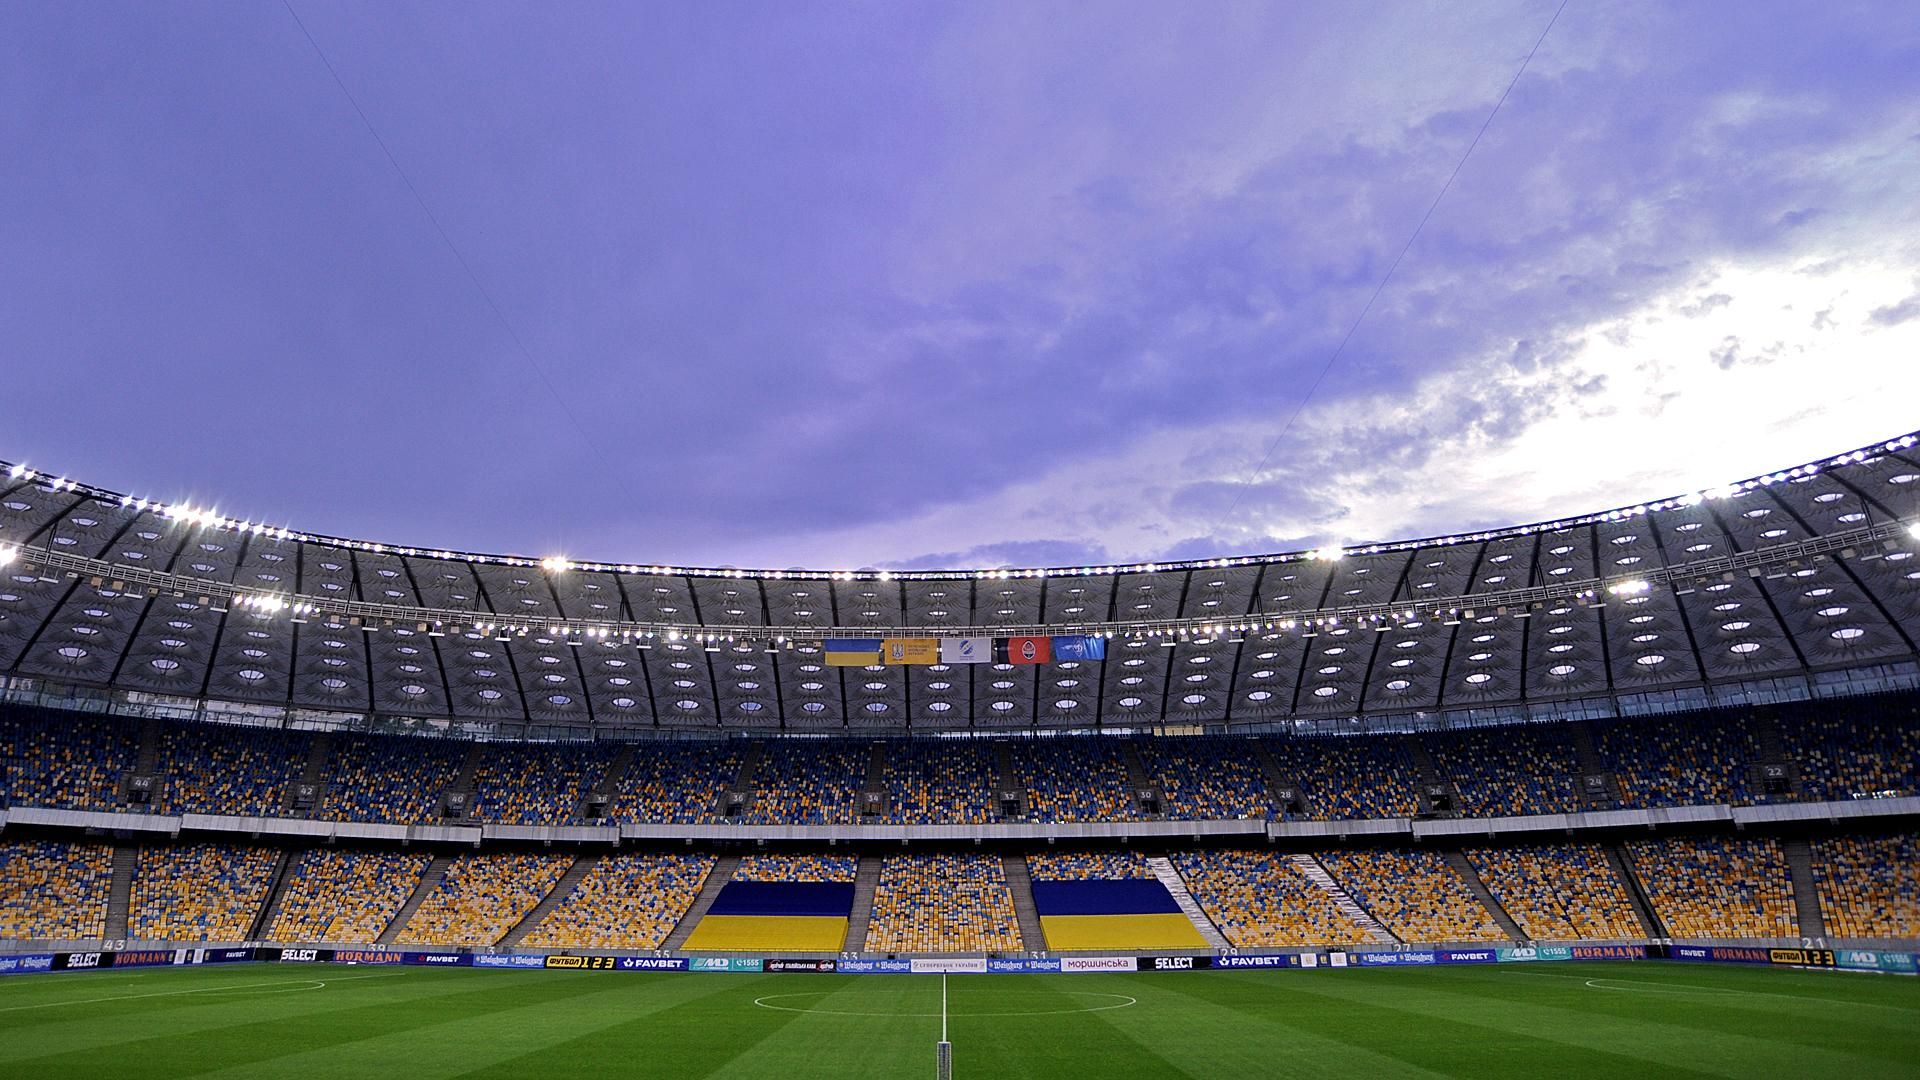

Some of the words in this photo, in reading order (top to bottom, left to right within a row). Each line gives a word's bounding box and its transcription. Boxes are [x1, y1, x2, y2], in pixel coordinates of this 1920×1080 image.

[1768, 768, 1783, 777] 22
[135, 779, 149, 787] 44
[1589, 778, 1602, 786] 24
[300, 787, 313, 795] 42
[1280, 791, 1291, 799] 28
[1431, 788, 1442, 796] 26
[452, 796, 463, 804] 40
[733, 794, 744, 802] 36
[868, 794, 879, 802] 34
[1140, 792, 1151, 800] 30
[103, 939, 125, 950] 43
[1802, 937, 1824, 949] 21
[1394, 944, 1411, 952] 27
[281, 949, 318, 961] SELECT
[654, 950, 670, 959] 35
[841, 952, 858, 960] 33
[1031, 951, 1046, 959] 31
[1451, 952, 1489, 960] FAVBET
[1680, 949, 1706, 957] FAVBET
[1773, 951, 1800, 961] ФУТБОЛ
[67, 953, 101, 968] SELECT
[549, 958, 579, 966] ФУТБОЛ
[581, 957, 589, 968] 1
[592, 957, 601, 968] 2
[604, 957, 614, 968] 3
[635, 959, 683, 968] FAVBET
[1067, 958, 1129, 970] моршинська
[1155, 957, 1193, 969] SELECT
[1231, 956, 1280, 966] FAVBET
